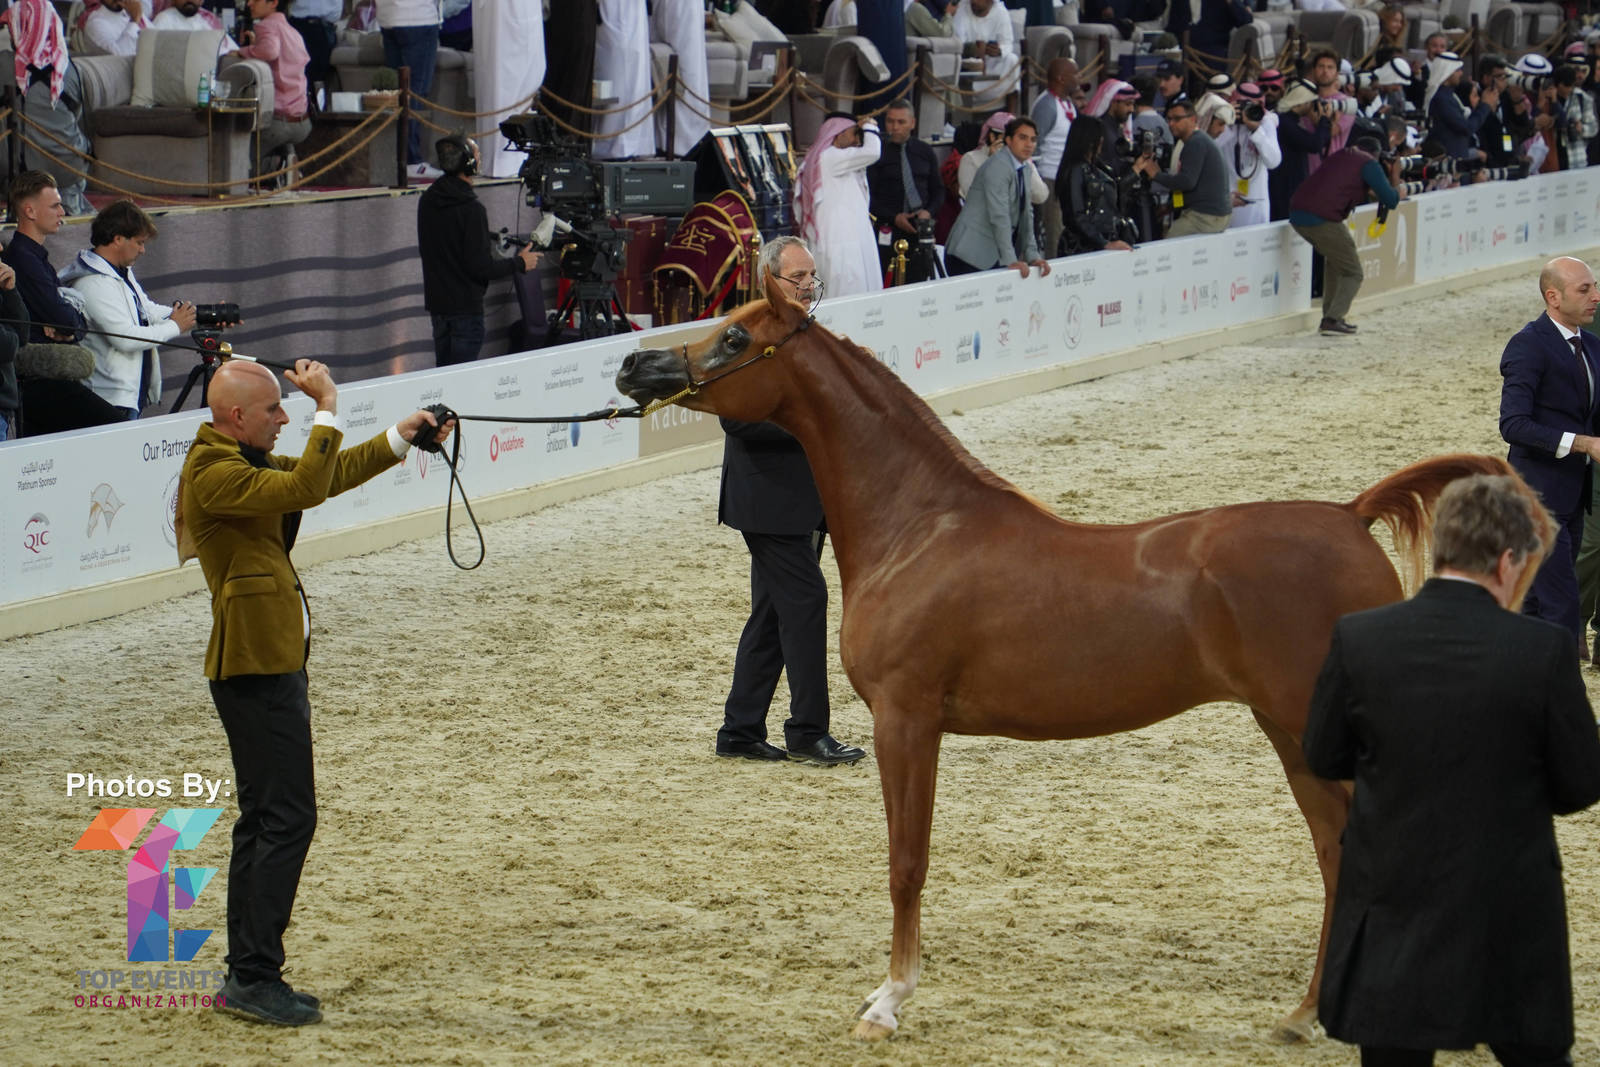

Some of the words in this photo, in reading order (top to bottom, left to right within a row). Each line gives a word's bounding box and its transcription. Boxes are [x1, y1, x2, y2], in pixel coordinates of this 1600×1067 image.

[143, 442, 159, 462] Our
[162, 439, 191, 458] Partner
[500, 435, 524, 453] vodafone
[18, 480, 38, 491] Platinum
[39, 477, 57, 488] Sponsor
[24, 530, 49, 554] QIC
